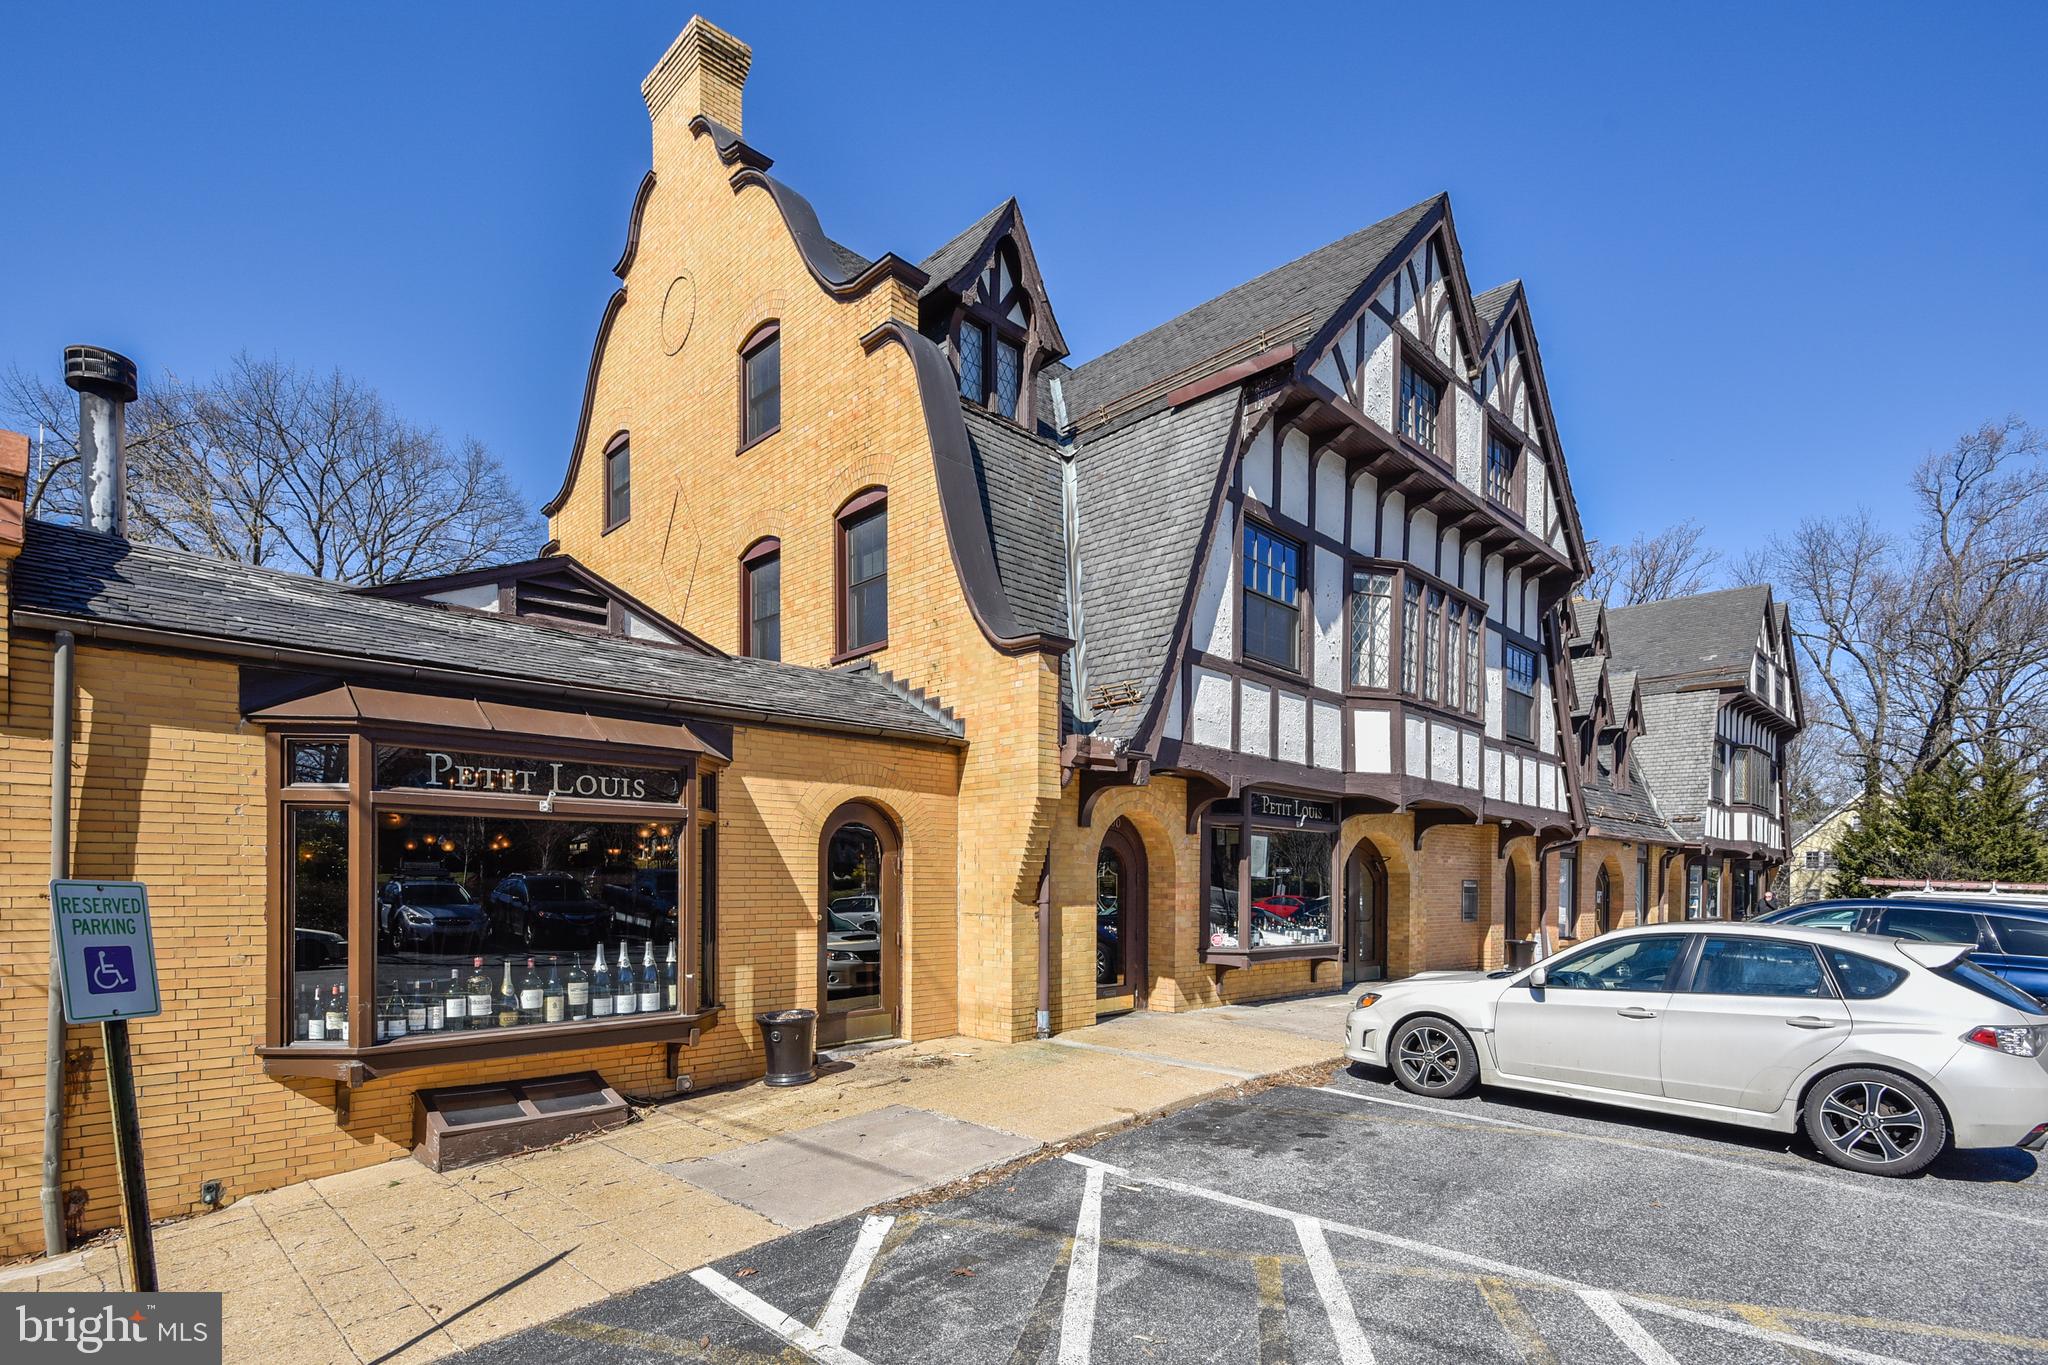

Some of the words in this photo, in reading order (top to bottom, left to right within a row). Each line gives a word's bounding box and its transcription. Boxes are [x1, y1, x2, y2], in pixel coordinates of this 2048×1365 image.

[425, 752, 537, 792] PETIT
[549, 763, 646, 799] LOUIS
[1261, 795, 1292, 816] PETIT
[1294, 800, 1323, 819] LOUIS
[61, 897, 141, 914] RESERVED
[72, 918, 137, 936] PARKING
